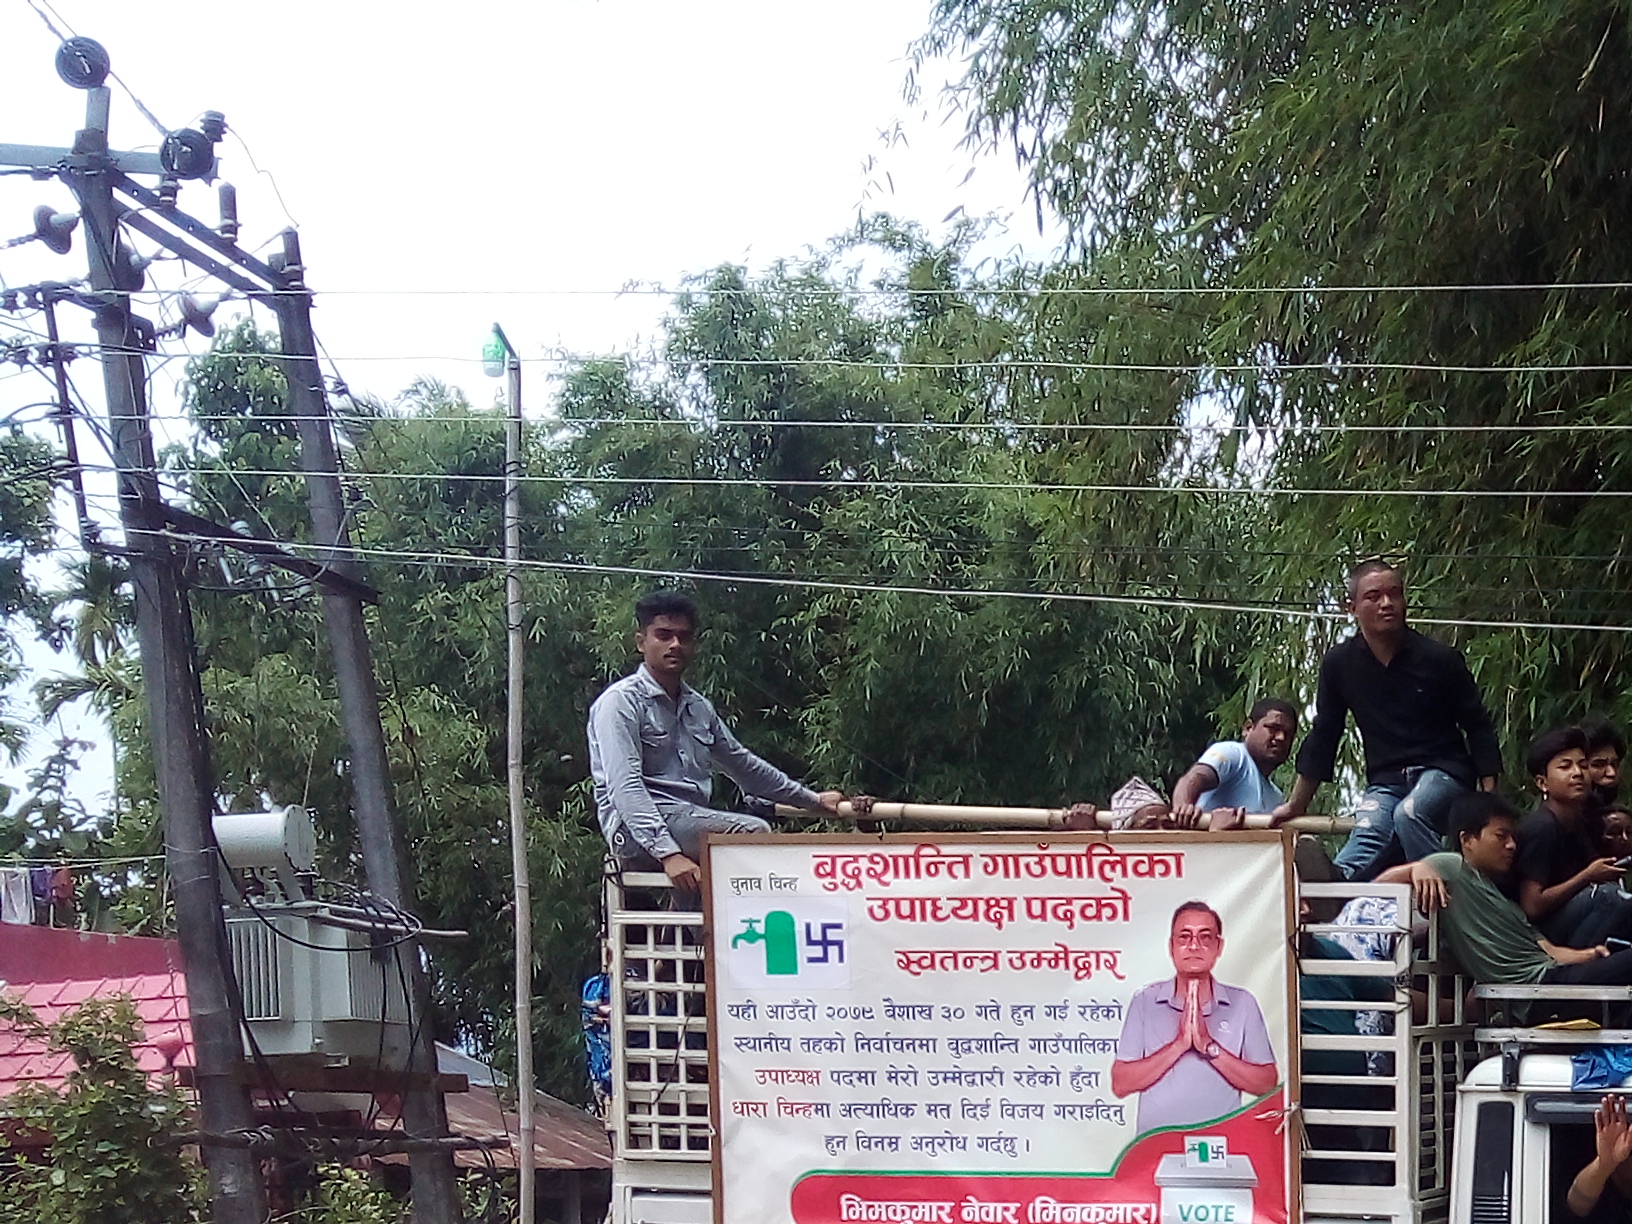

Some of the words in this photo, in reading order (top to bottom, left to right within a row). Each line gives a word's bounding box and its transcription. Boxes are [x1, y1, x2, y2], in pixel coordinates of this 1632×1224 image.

[811, 843, 974, 891] बुद्धशान्ति
[979, 843, 1185, 882] गाउँपालिका
[730, 877, 763, 896] चुनाव
[768, 873, 799, 892] चिन्ह
[866, 897, 1018, 931] उपाध्यक्ष
[1023, 886, 1132, 930] पदको
[894, 950, 1002, 976] स्वतन्त्र
[1006, 942, 1127, 981] उम्मेद्वार
[727, 998, 758, 1021] यही
[765, 998, 818, 1022] आउँदो
[825, 1005, 875, 1021] २०७९
[941, 1006, 966, 1022] ३०
[975, 999, 1002, 1022] गते
[1010, 1004, 1036, 1027] हुन
[1044, 998, 1070, 1021] गई
[1078, 998, 1123, 1022] रहेको
[734, 1032, 792, 1053] स्थानीय
[800, 1031, 846, 1054] तहको
[855, 1031, 938, 1053] निर्वाचनमा
[947, 1032, 1020, 1059] बुद्धशान्ति
[1028, 1032, 1120, 1055] गाउँपालिका
[755, 1069, 821, 1086] उपाध्यक्ष
[829, 1070, 877, 1088] पदमा
[885, 1064, 919, 1087] मेरो
[927, 1065, 1005, 1088] उम्मेद्वारी
[1013, 1065, 1062, 1088] रहेको
[1069, 1065, 1101, 1092] हुँदा
[733, 1101, 768, 1118] धारा
[776, 1096, 831, 1118] चिन्हमा
[839, 1097, 917, 1119] अत्याधिक
[925, 1103, 952, 1120] मत
[961, 1098, 991, 1120] दिई
[1000, 1098, 1045, 1120] विजय
[1054, 1099, 1126, 1126] गराइदिनु
[824, 1135, 848, 1156] हुन
[855, 1130, 902, 1153] विनम्र
[910, 1130, 968, 1157] अनुरोध
[977, 1131, 1018, 1158] गर्दछु
[1177, 1203, 1235, 1223] VOTE
